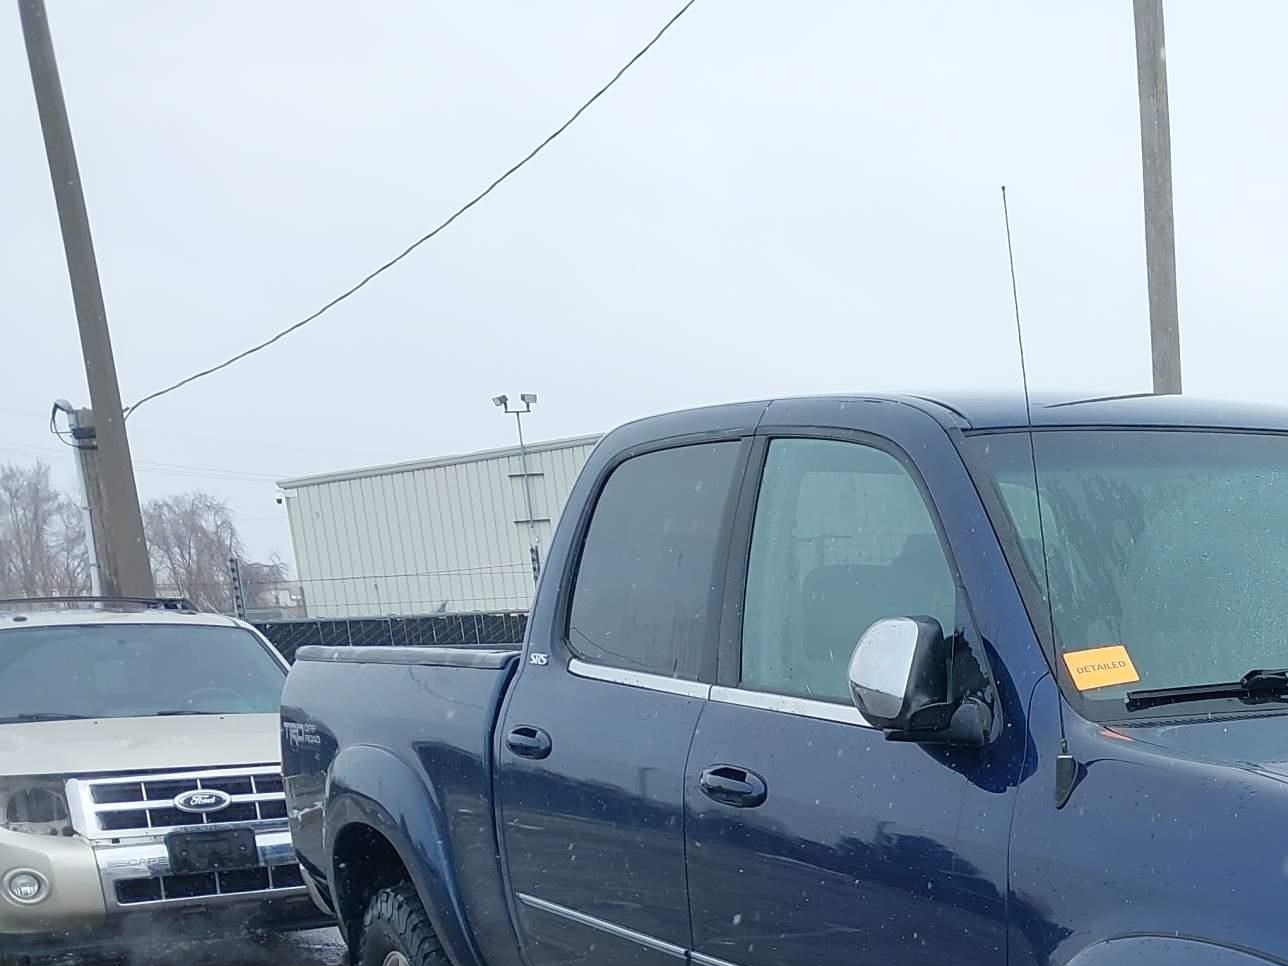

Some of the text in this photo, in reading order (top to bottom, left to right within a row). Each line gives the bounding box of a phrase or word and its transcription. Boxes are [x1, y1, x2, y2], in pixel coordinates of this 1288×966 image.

[1076, 660, 1126, 675] DETAILED
[283, 721, 305, 747] TRD
[190, 794, 216, 806] Ford
